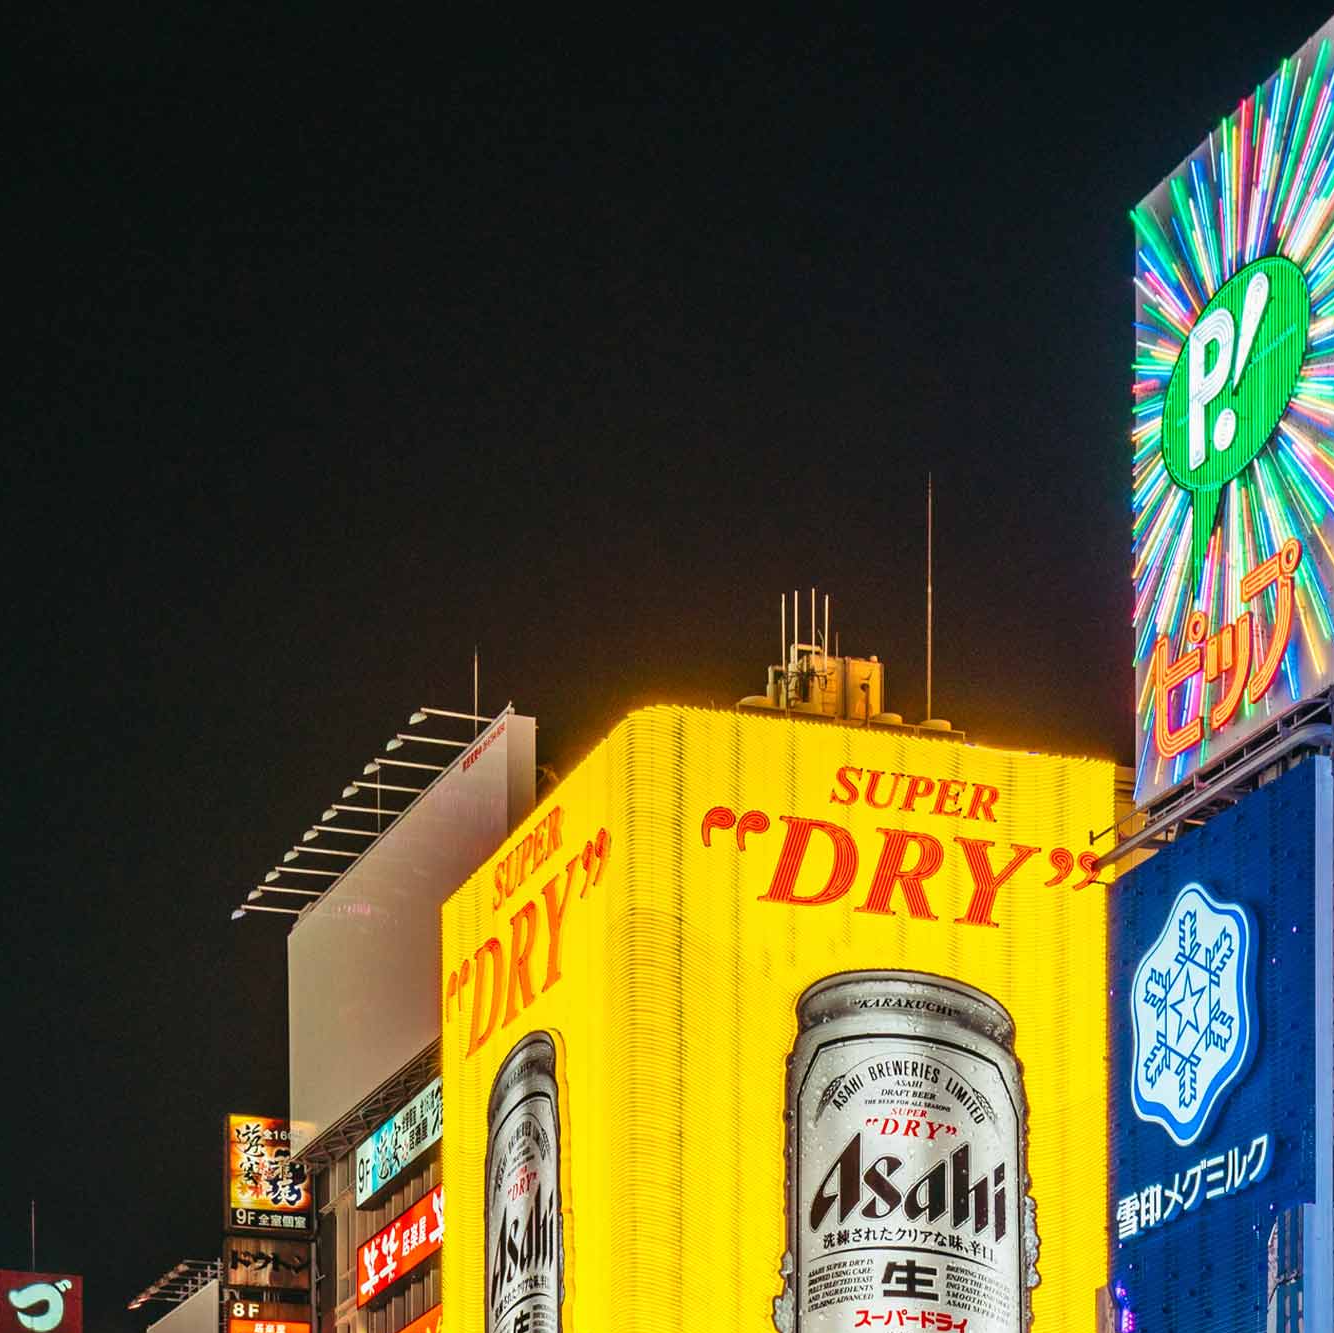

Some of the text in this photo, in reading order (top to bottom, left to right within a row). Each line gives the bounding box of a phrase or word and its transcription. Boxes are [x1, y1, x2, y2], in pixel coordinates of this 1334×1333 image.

[1149, 539, 1302, 759] ピップ
[830, 766, 1000, 823] SUPER
[493, 805, 562, 911] SUPER
[832, 1060, 985, 1125] ASAHI BREWERIES LIMITED
[890, 1108, 928, 1118] SUPER
[235, 1210, 256, 1225] 9F
[810, 1131, 1007, 1243] Asahi
[1116, 1134, 1269, 1240] 雪印メグミルク
[491, 1182, 554, 1309] Asahi
[881, 1259, 939, 1302] 生
